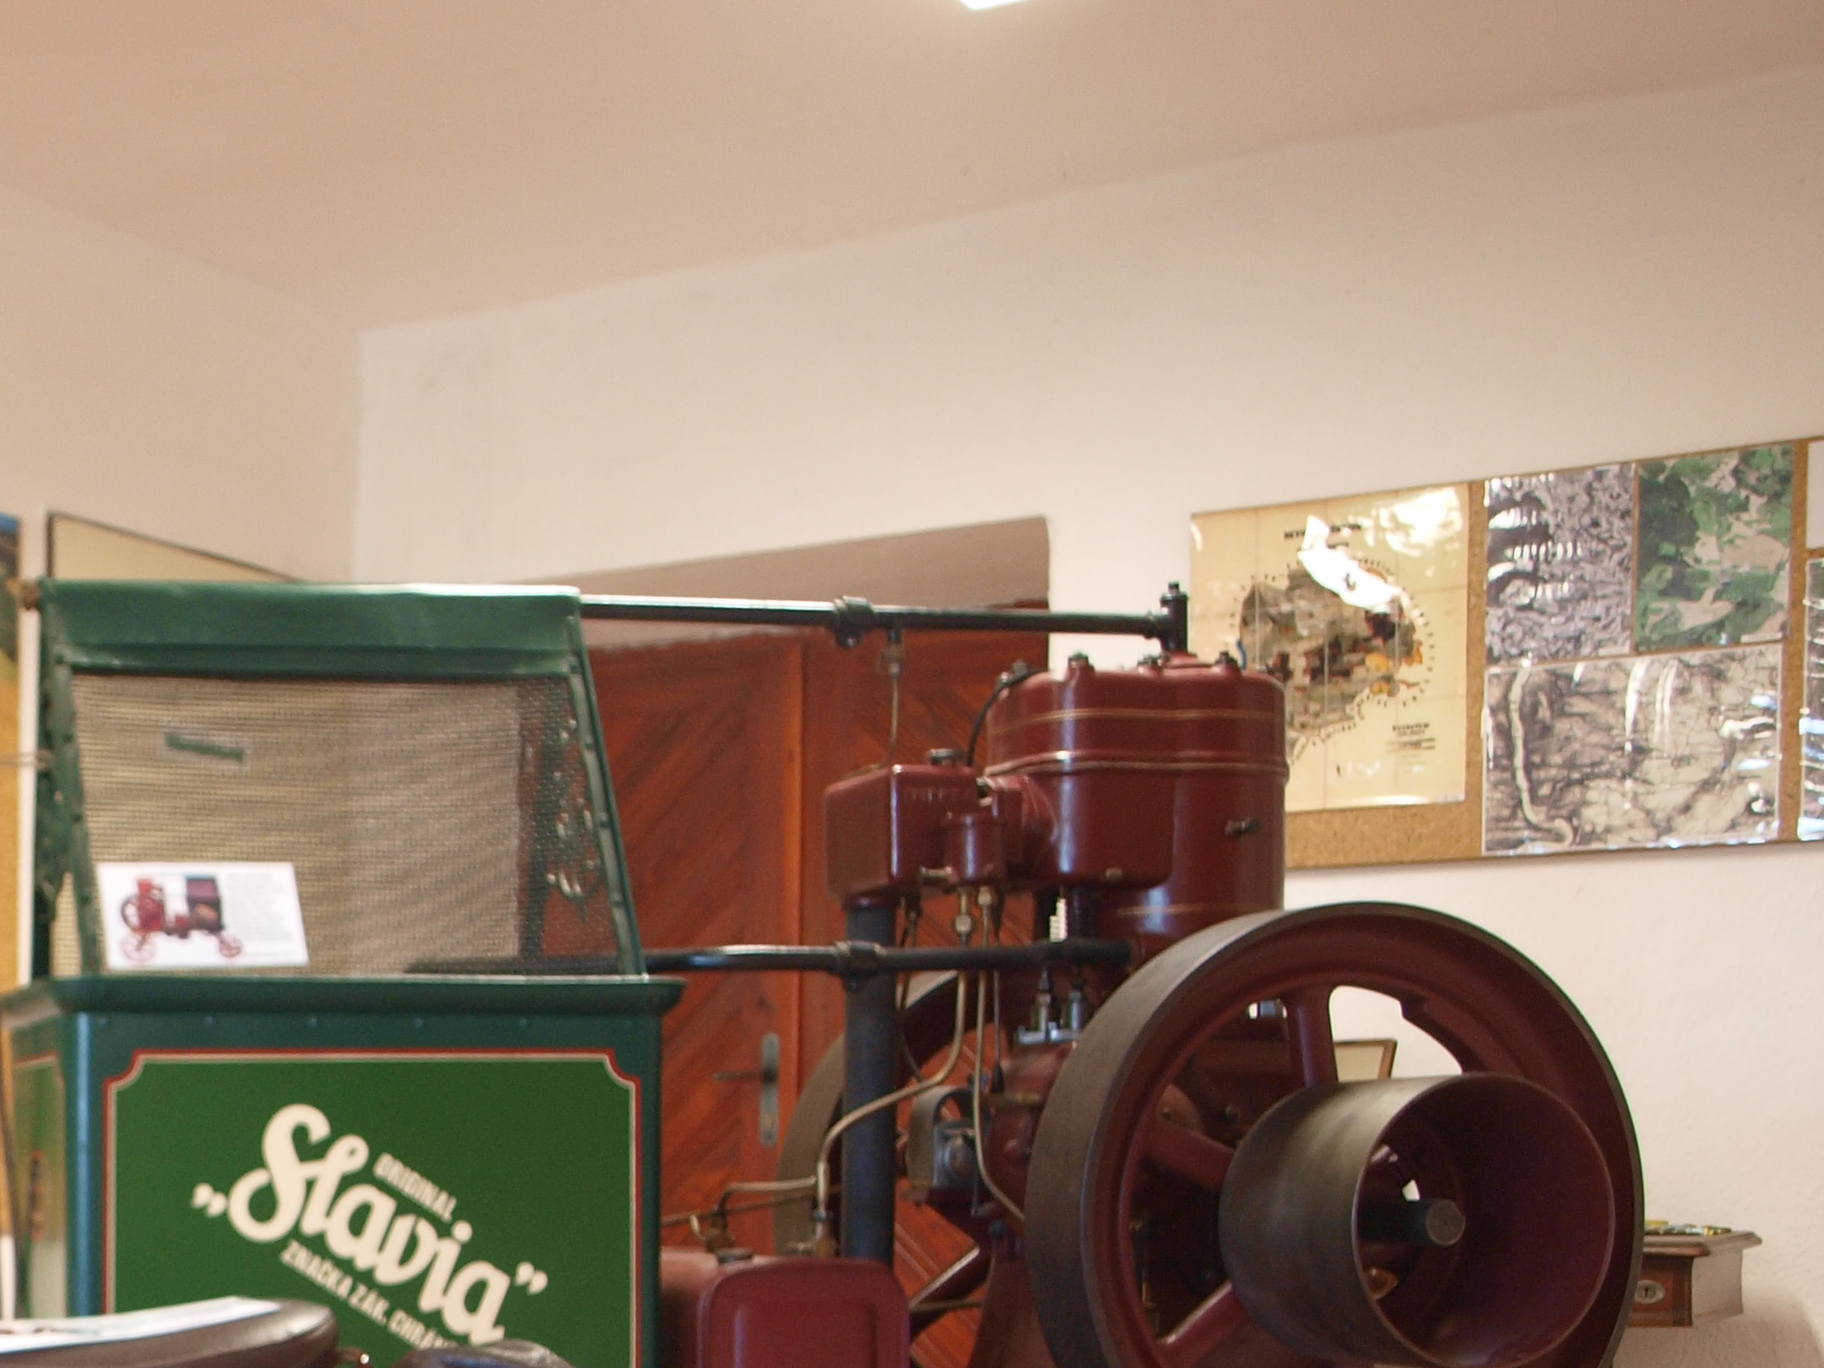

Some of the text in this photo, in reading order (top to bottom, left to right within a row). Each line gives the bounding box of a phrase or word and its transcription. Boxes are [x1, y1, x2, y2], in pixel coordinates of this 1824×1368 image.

[373, 1151, 458, 1223] ORIGINAL
[280, 1239, 354, 1301] ZNAČKA
[388, 1308, 460, 1349] CHRÁ
